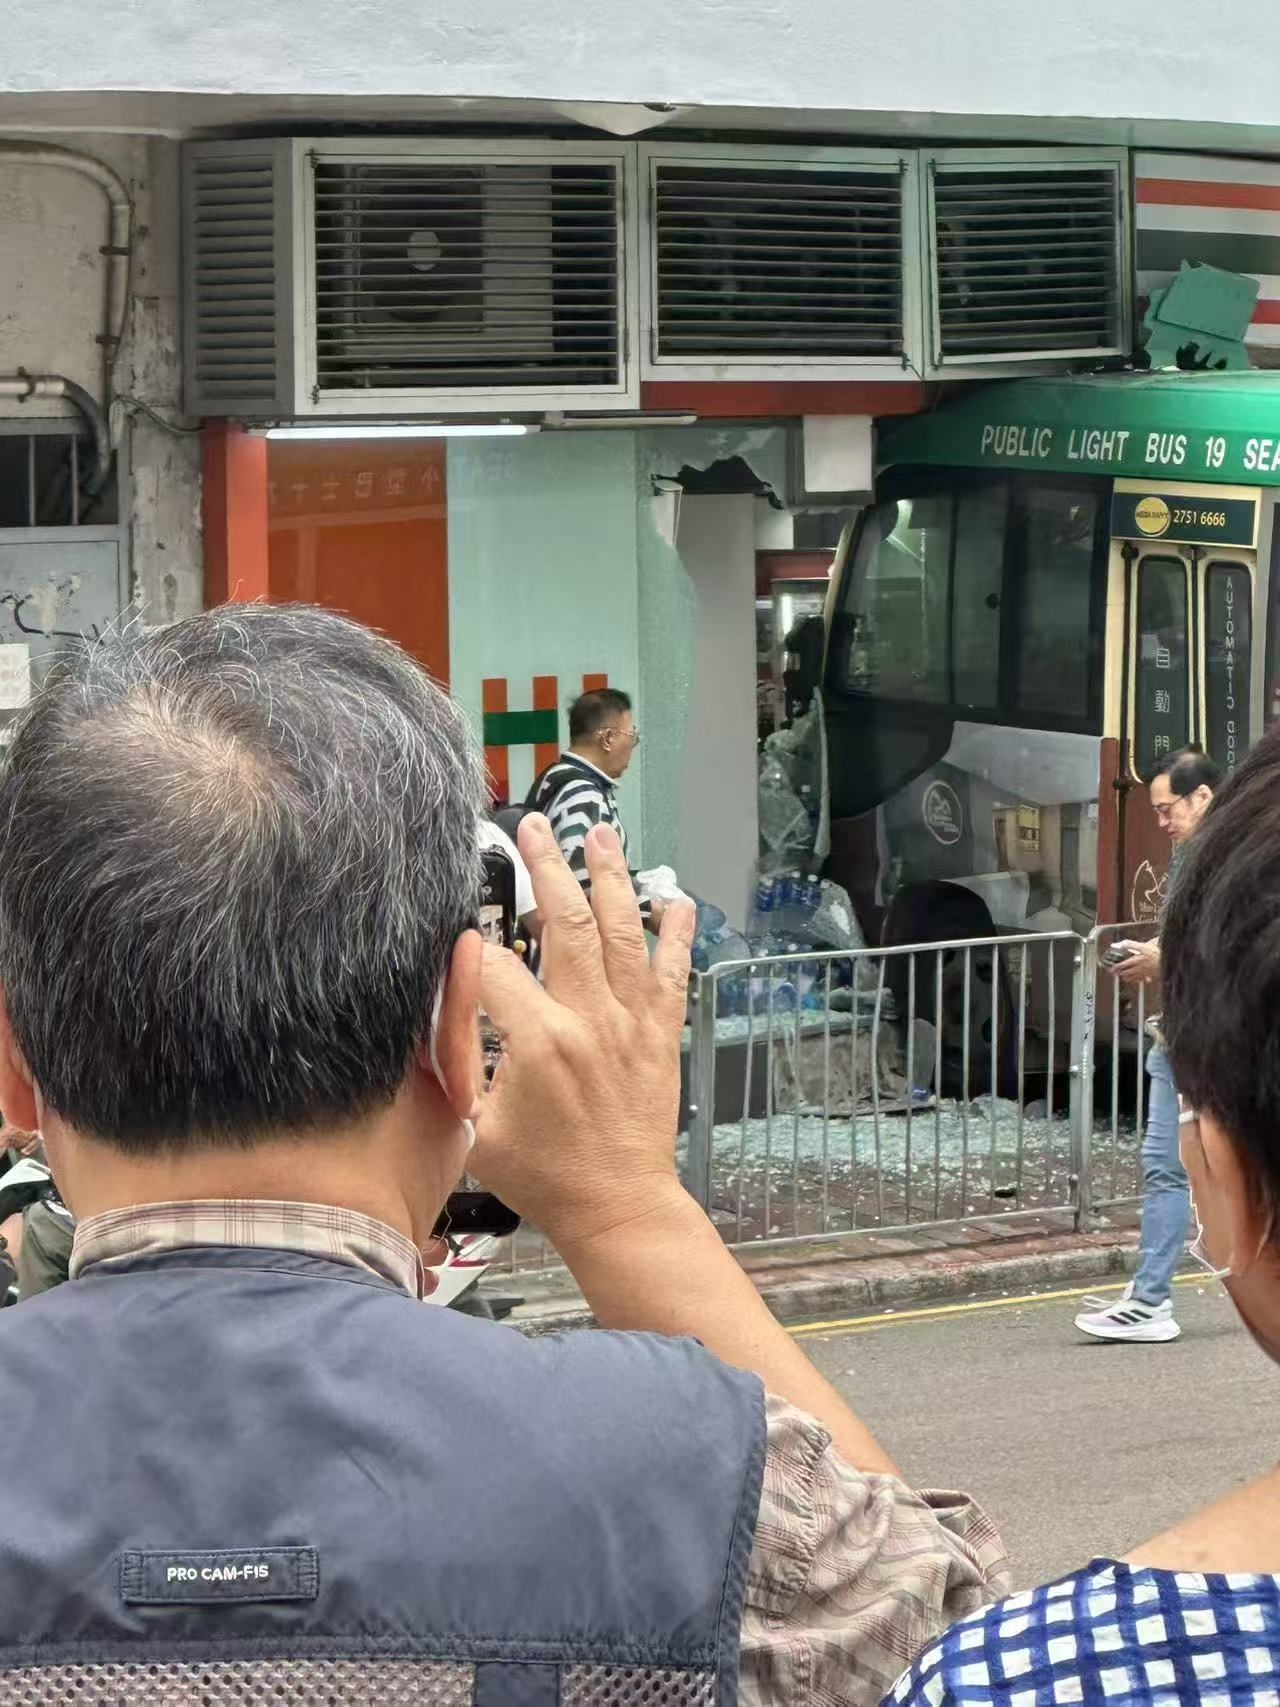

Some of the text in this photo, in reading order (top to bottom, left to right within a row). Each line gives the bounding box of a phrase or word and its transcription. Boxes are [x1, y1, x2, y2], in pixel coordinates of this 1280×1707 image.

[981, 424, 1053, 458] PUBLIC
[1067, 429, 1130, 462] LIGHT
[1145, 432, 1187, 465] BUS
[1205, 435, 1226, 468] 19
[1173, 509, 1197, 525] 2751
[1200, 511, 1226, 527] 6666
[167, 1565, 269, 1581] PRO CAM-FIS
